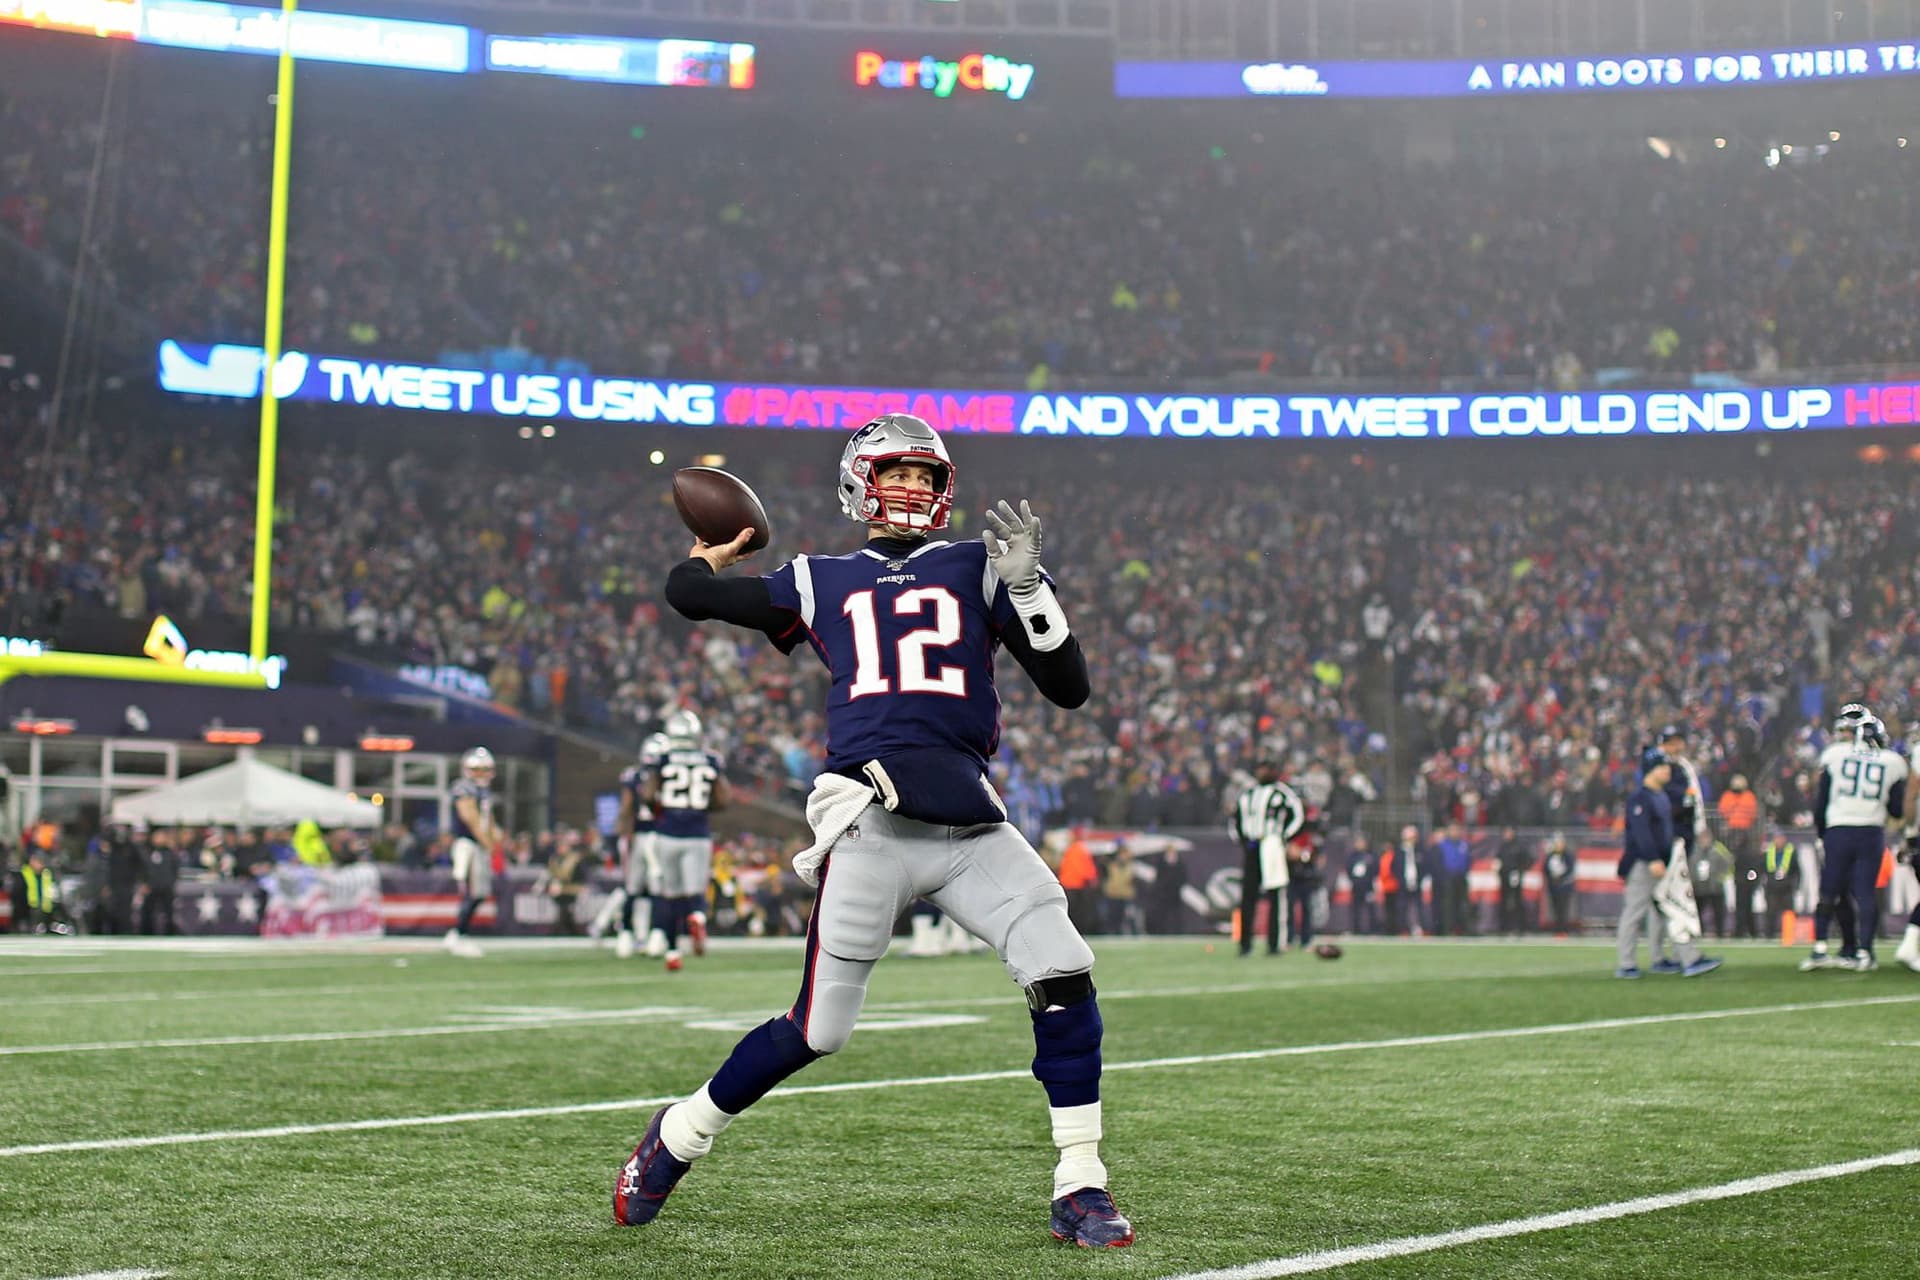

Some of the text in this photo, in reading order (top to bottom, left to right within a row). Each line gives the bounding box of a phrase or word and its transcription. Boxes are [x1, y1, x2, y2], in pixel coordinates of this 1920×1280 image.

[1467, 44, 1920, 90] A FAN ROOTS FOR THEIR TE
[318, 359, 1920, 437] TWEET US USING #PATSGAME AND YOUR TWEET COULD END UP HE
[876, 574, 917, 585] PATRIOTS
[842, 584, 968, 701] 12
[1839, 758, 1886, 800] 99
